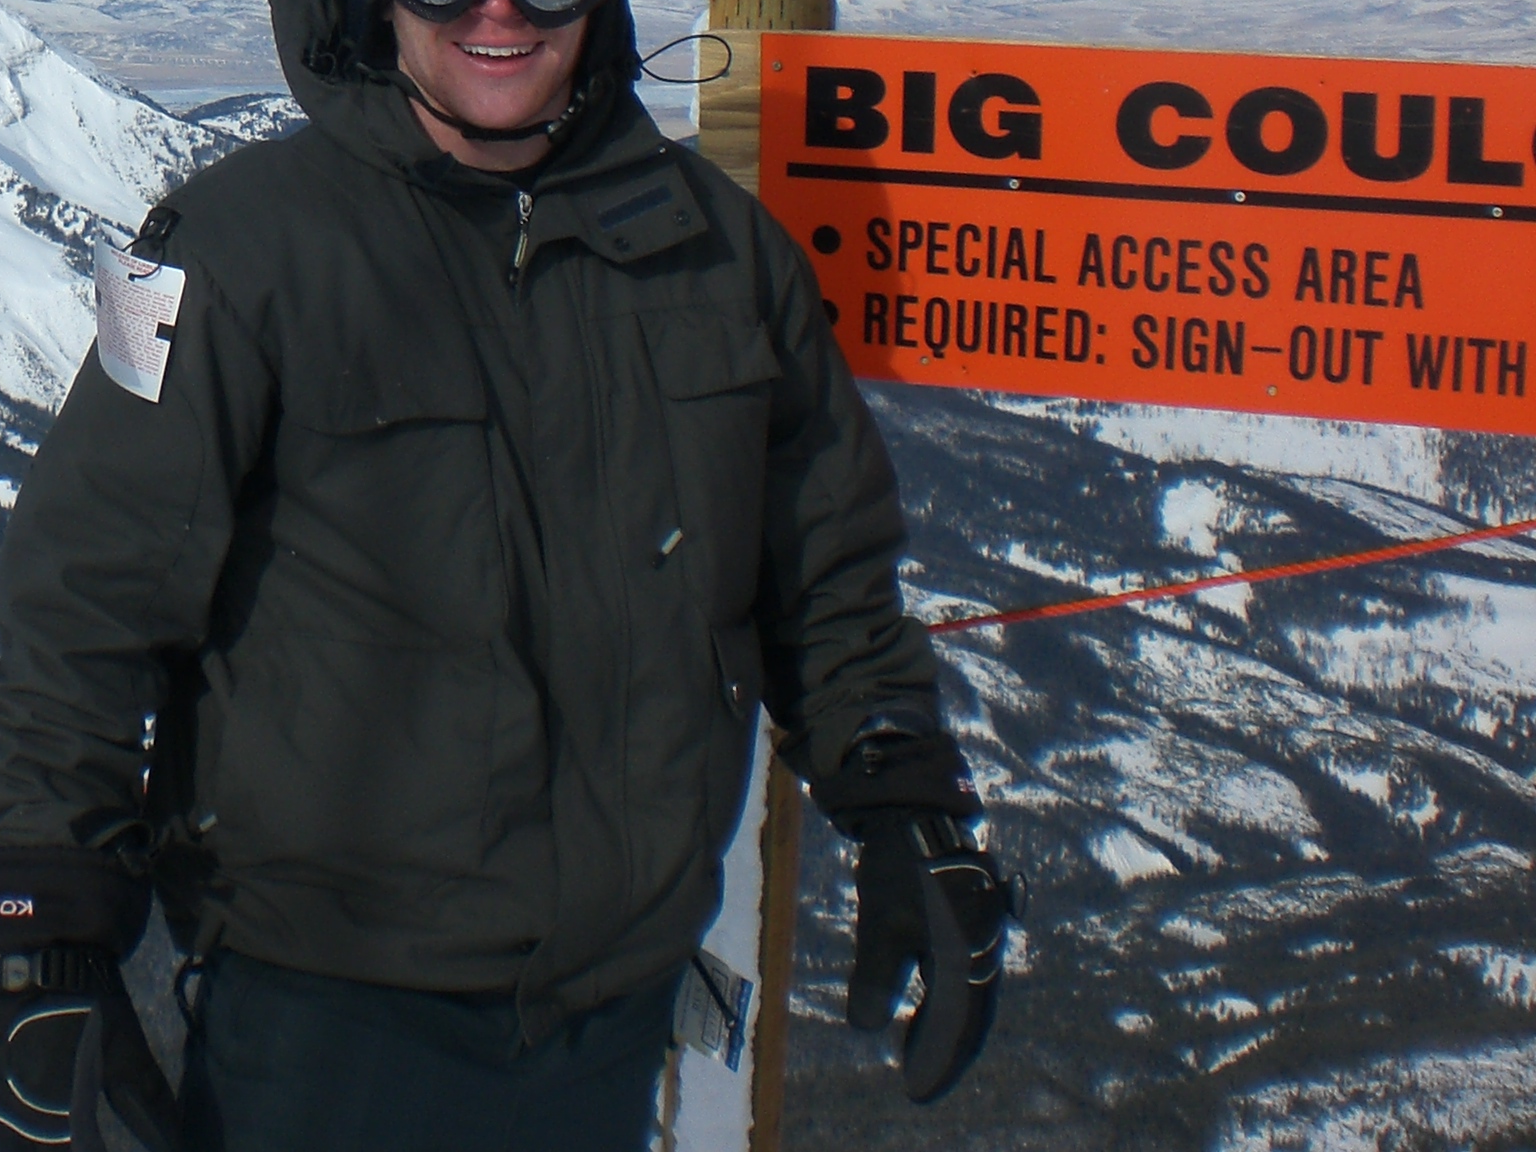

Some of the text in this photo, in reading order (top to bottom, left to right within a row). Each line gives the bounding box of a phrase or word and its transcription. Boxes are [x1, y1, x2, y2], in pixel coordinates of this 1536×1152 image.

[804, 65, 1536, 187] BIG COUL
[865, 216, 1424, 310] SPECIAL ACCESS AREA
[864, 292, 1527, 398] REQUIRED: SIGN-OUT WITH
